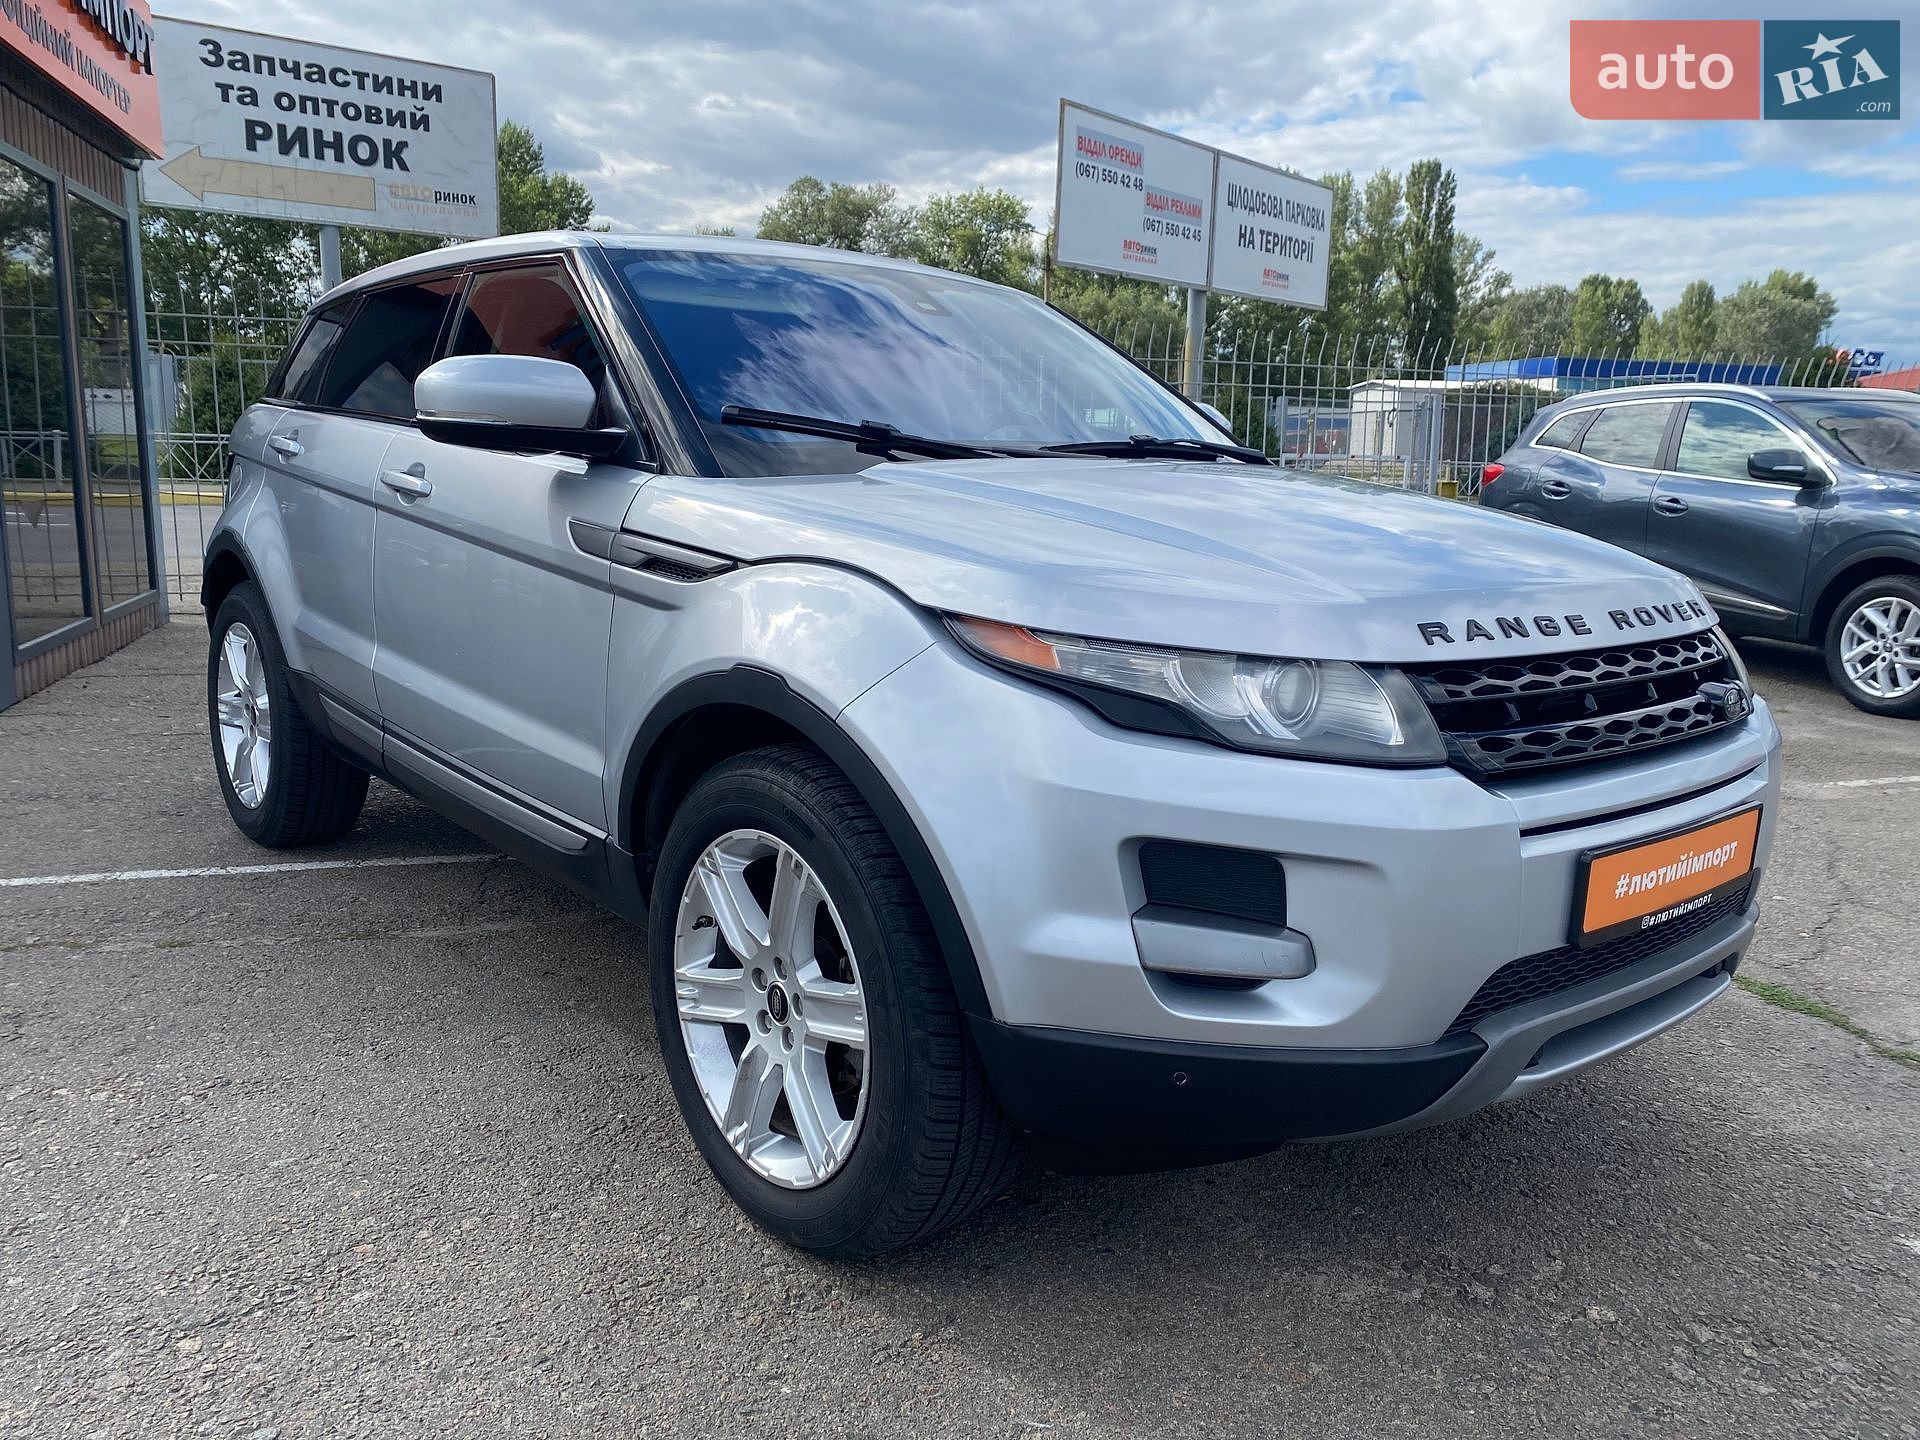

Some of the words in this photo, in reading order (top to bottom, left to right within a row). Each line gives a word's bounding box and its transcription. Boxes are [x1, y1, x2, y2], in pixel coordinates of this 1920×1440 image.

[198, 38, 444, 103] Запчастини
[215, 81, 260, 108] та
[273, 87, 431, 133] оптовий
[244, 118, 412, 172] РИНОК
[1077, 135, 1107, 158] ВІДДІЛ
[1108, 144, 1142, 168] ОРЕНДИ
[1075, 161, 1100, 183] (067)
[1101, 168, 1118, 185] 550
[1120, 174, 1131, 189] 42
[1133, 177, 1144, 192] 48
[1146, 191, 1169, 213] ВІДДІЛ
[1170, 198, 1203, 219] РЕКЛАМИ
[1227, 182, 1284, 221] ЦІЛОДОБОВА
[1285, 199, 1325, 233] ПАРКОВКА
[1143, 216, 1164, 236] (067)
[1165, 222, 1180, 237] 550
[1181, 225, 1191, 240] 42
[1192, 228, 1202, 242] 45
[1238, 224, 1256, 250] НА
[1259, 228, 1316, 264] ТЕРИТОРІЇ
[1416, 613, 1594, 646] RANGE
[1608, 599, 1707, 631] ROVER
[1614, 840, 1738, 899] #лютийімпорт
